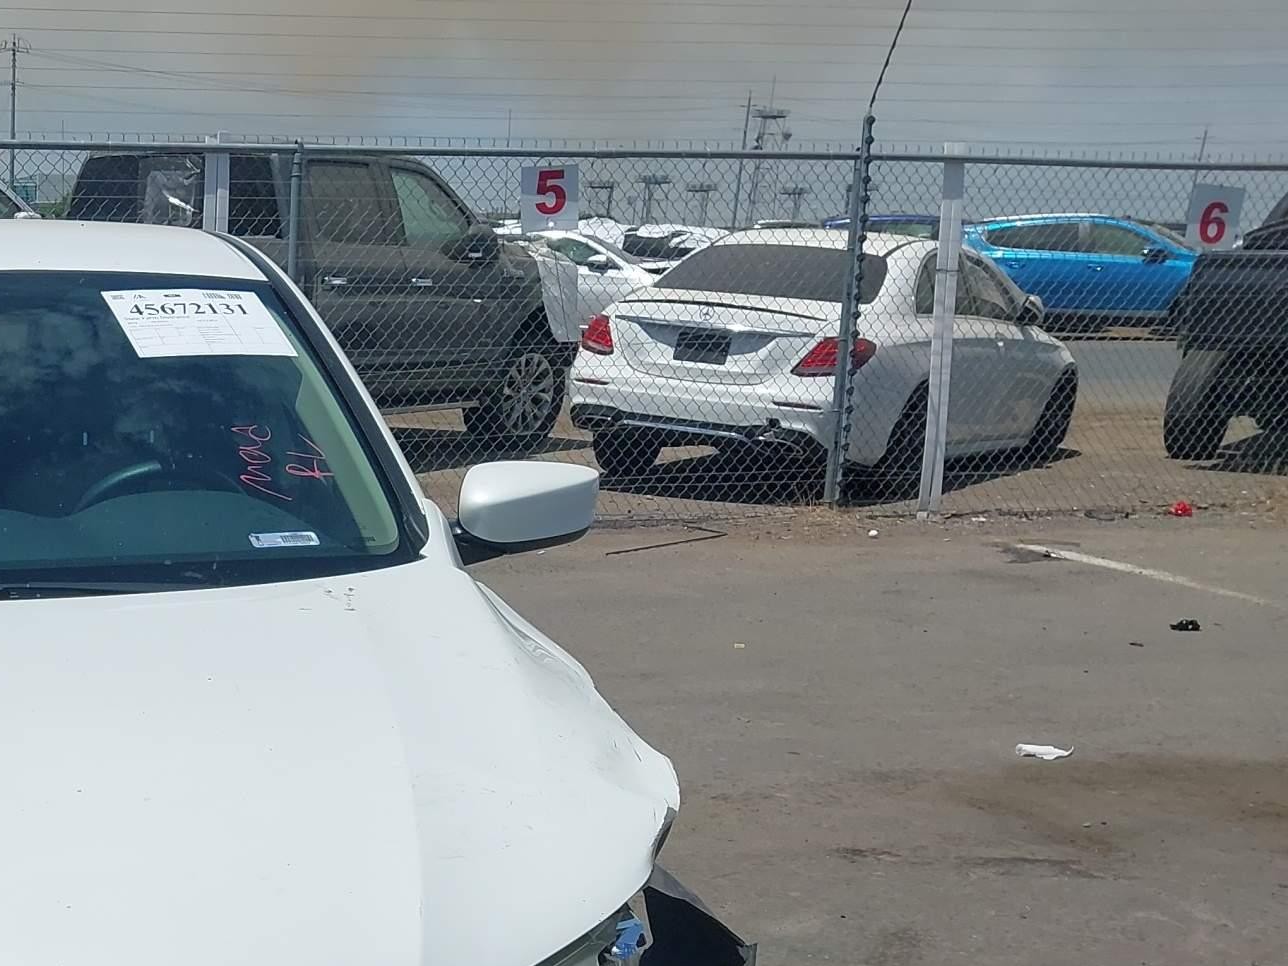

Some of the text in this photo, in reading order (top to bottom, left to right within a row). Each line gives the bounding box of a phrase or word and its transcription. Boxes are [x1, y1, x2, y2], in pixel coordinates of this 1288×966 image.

[535, 168, 567, 216] 5
[1199, 201, 1230, 245] 6
[129, 302, 249, 316] 45672131
